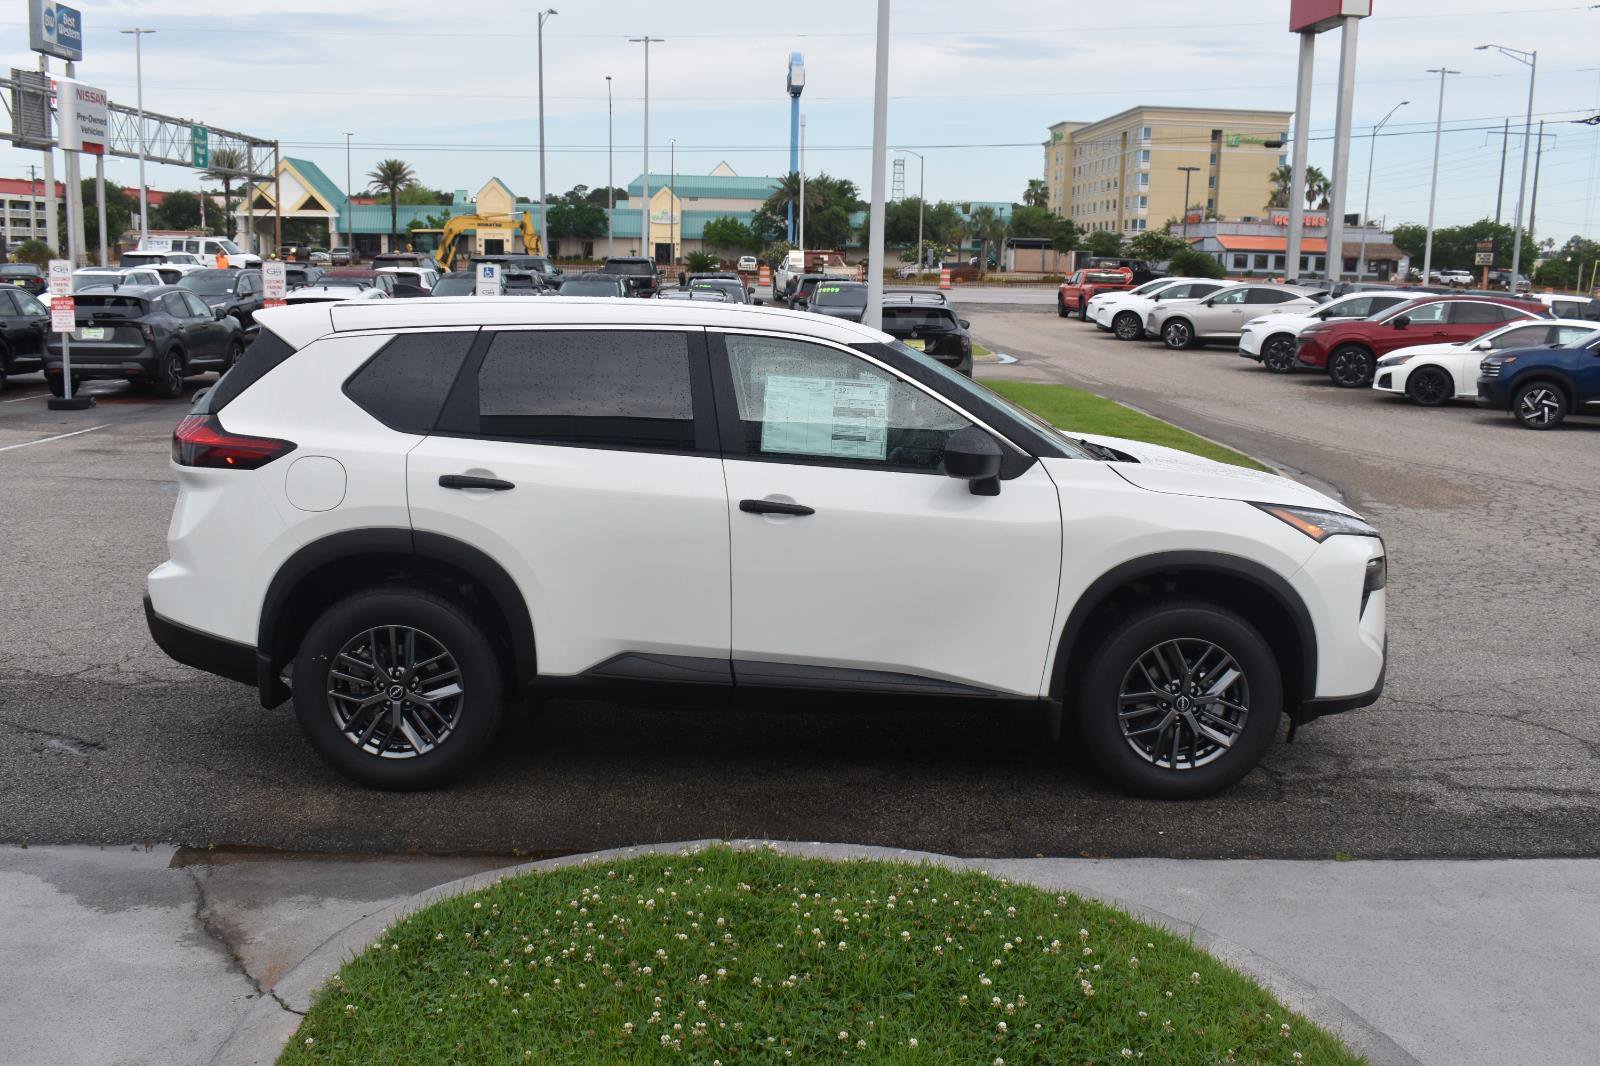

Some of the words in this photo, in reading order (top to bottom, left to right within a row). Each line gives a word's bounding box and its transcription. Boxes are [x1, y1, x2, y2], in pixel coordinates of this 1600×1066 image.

[63, 13, 76, 28] Best
[58, 23, 81, 40] Western
[76, 88, 107, 105] NISSAN
[76, 112, 108, 126] Pre-Owned
[80, 125, 105, 137] Vehicles
[1274, 215, 1328, 227] HOERS
